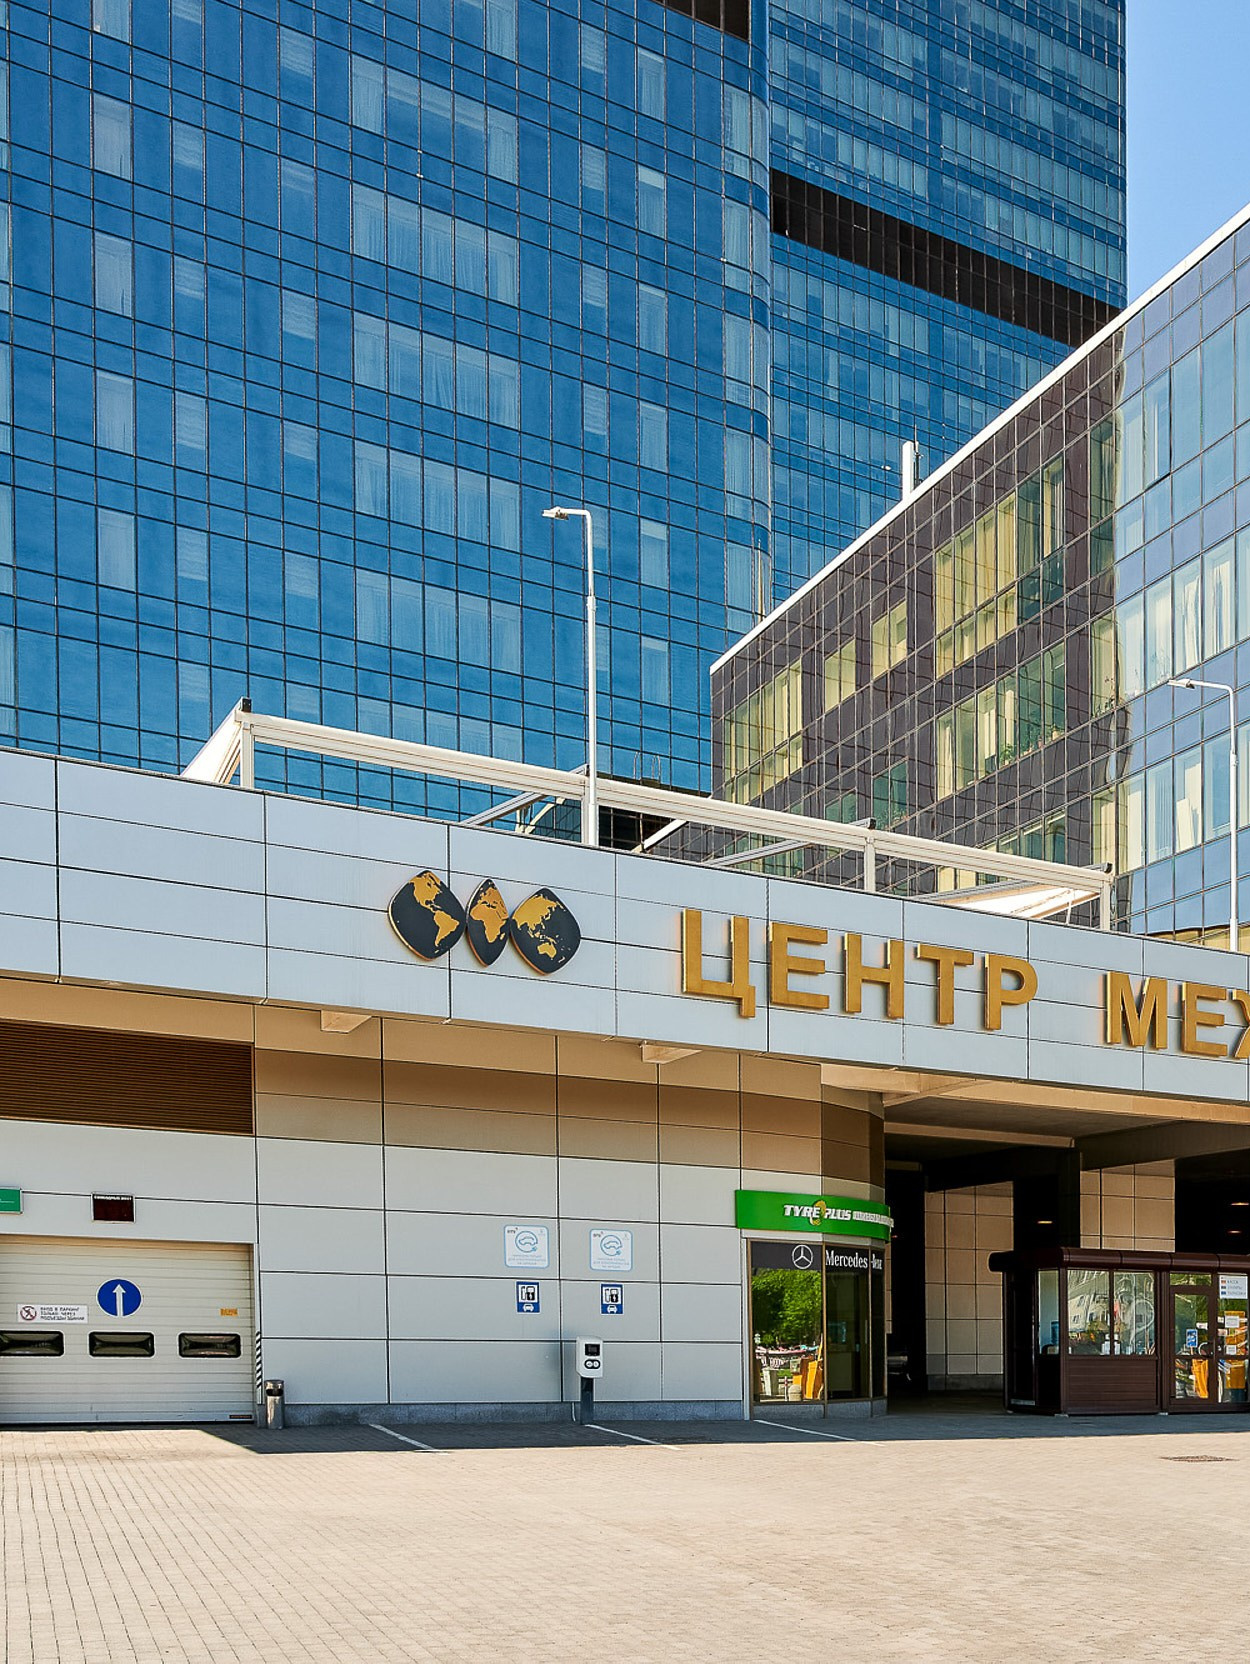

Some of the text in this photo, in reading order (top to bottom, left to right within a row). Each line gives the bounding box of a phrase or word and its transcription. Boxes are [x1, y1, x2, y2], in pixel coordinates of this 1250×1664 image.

[681, 907, 1039, 1031] ЦЕНТР
[783, 1204, 820, 1218] TYRE
[824, 1208, 852, 1220] PLUS
